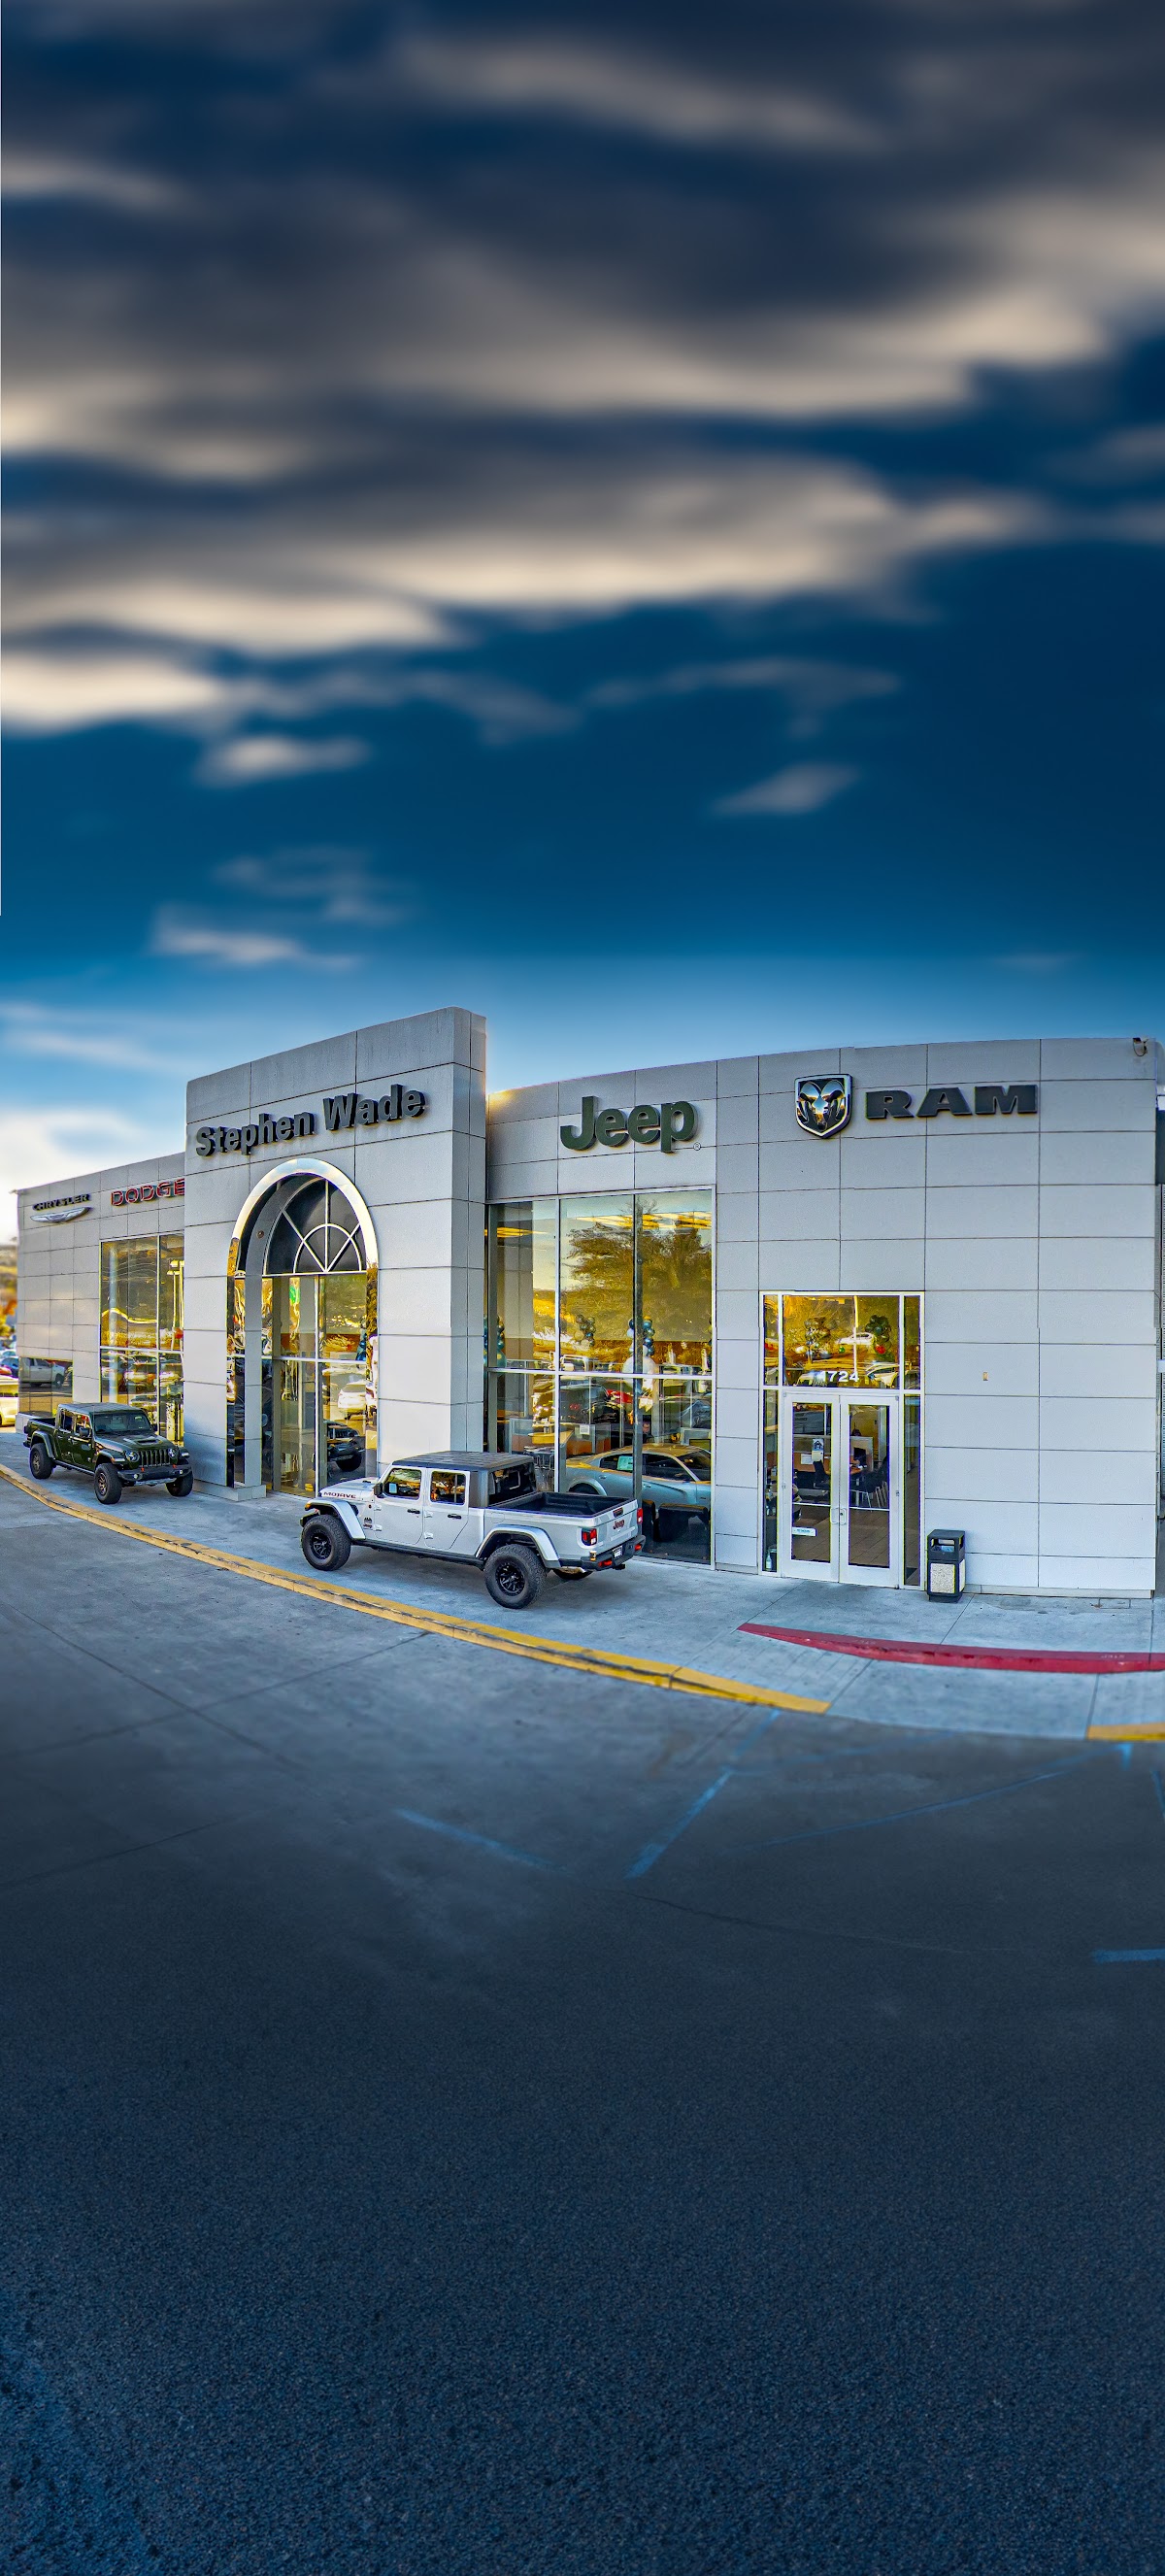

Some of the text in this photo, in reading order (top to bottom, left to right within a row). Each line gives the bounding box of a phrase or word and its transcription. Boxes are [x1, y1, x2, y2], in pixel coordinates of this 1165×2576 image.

[196, 1083, 426, 1156] Stephen Wade
[865, 1084, 1038, 1121] RAM
[560, 1095, 698, 1154] Jeep
[33, 1193, 91, 1211] CHRYSLER
[111, 1178, 184, 1207] DODGE
